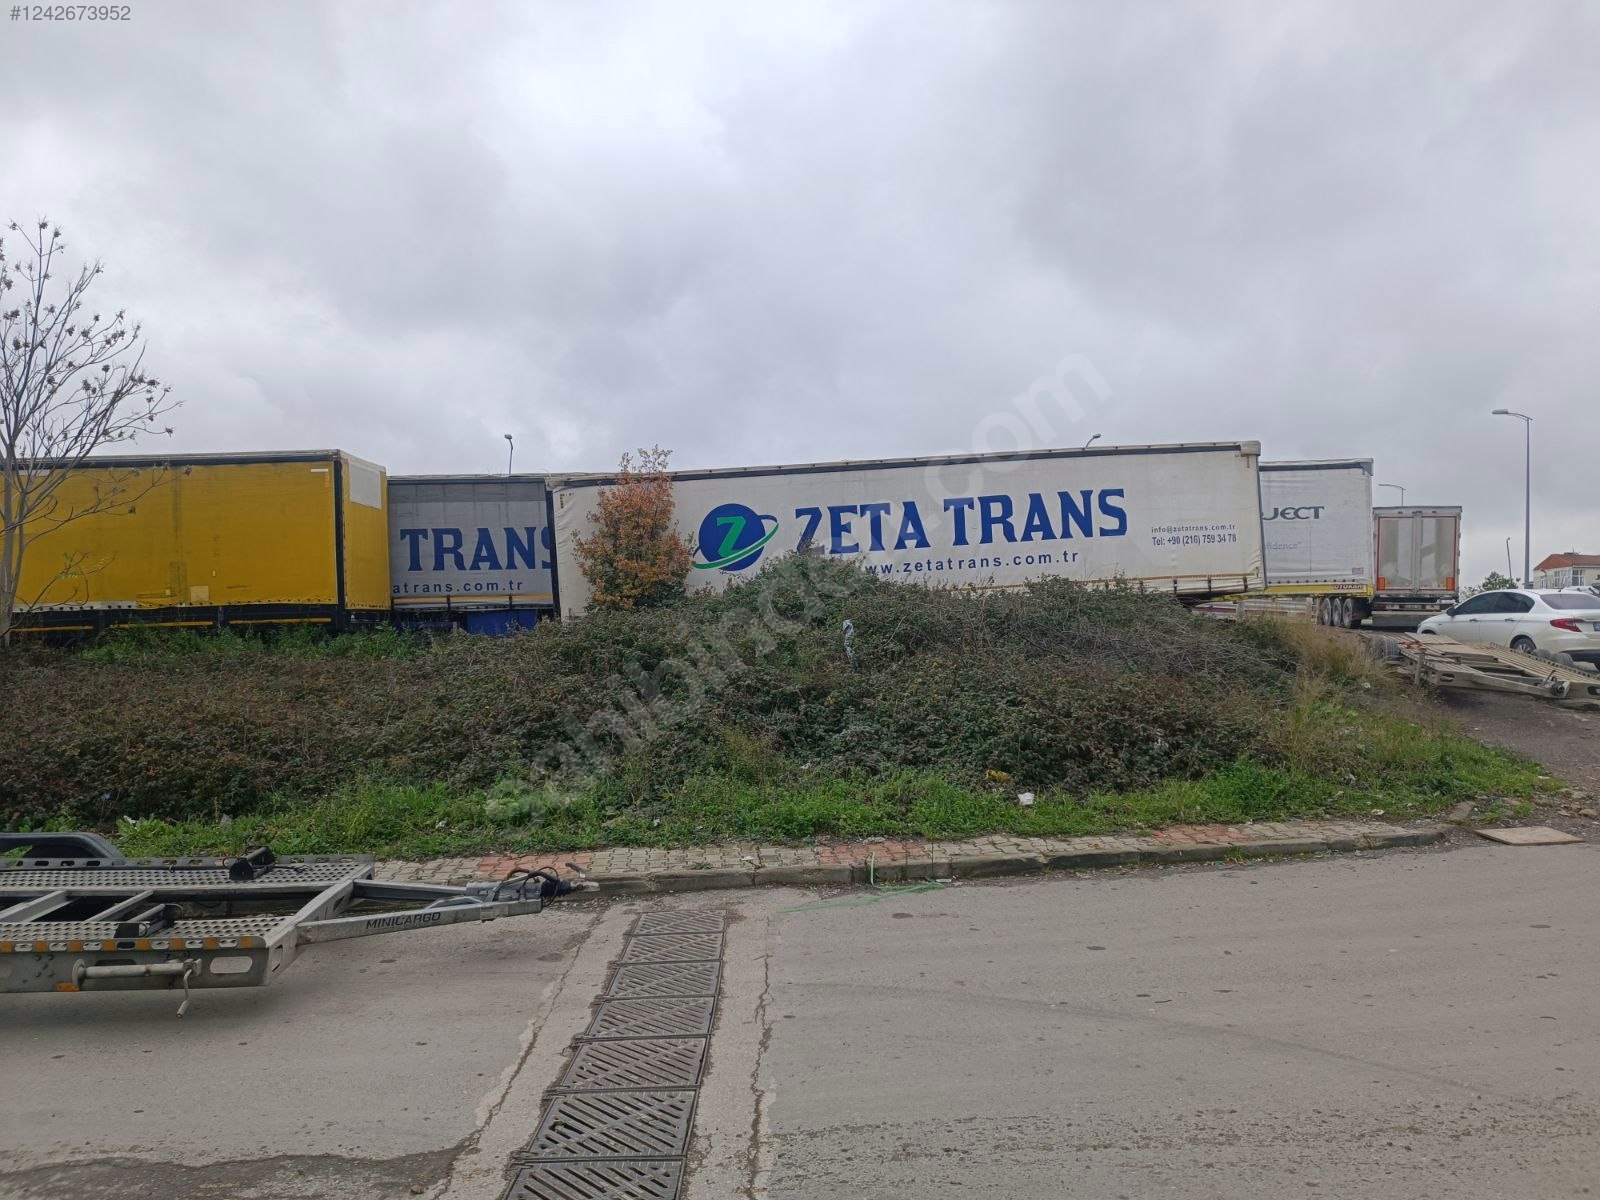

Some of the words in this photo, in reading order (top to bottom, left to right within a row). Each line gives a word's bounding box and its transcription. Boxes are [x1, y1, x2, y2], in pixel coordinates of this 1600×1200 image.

[1262, 506, 1325, 521] JECT
[795, 499, 931, 556] ZETA
[944, 488, 1127, 545] TRANS
[1264, 542, 1298, 550] fidence
[366, 911, 442, 929] MINICARGO
